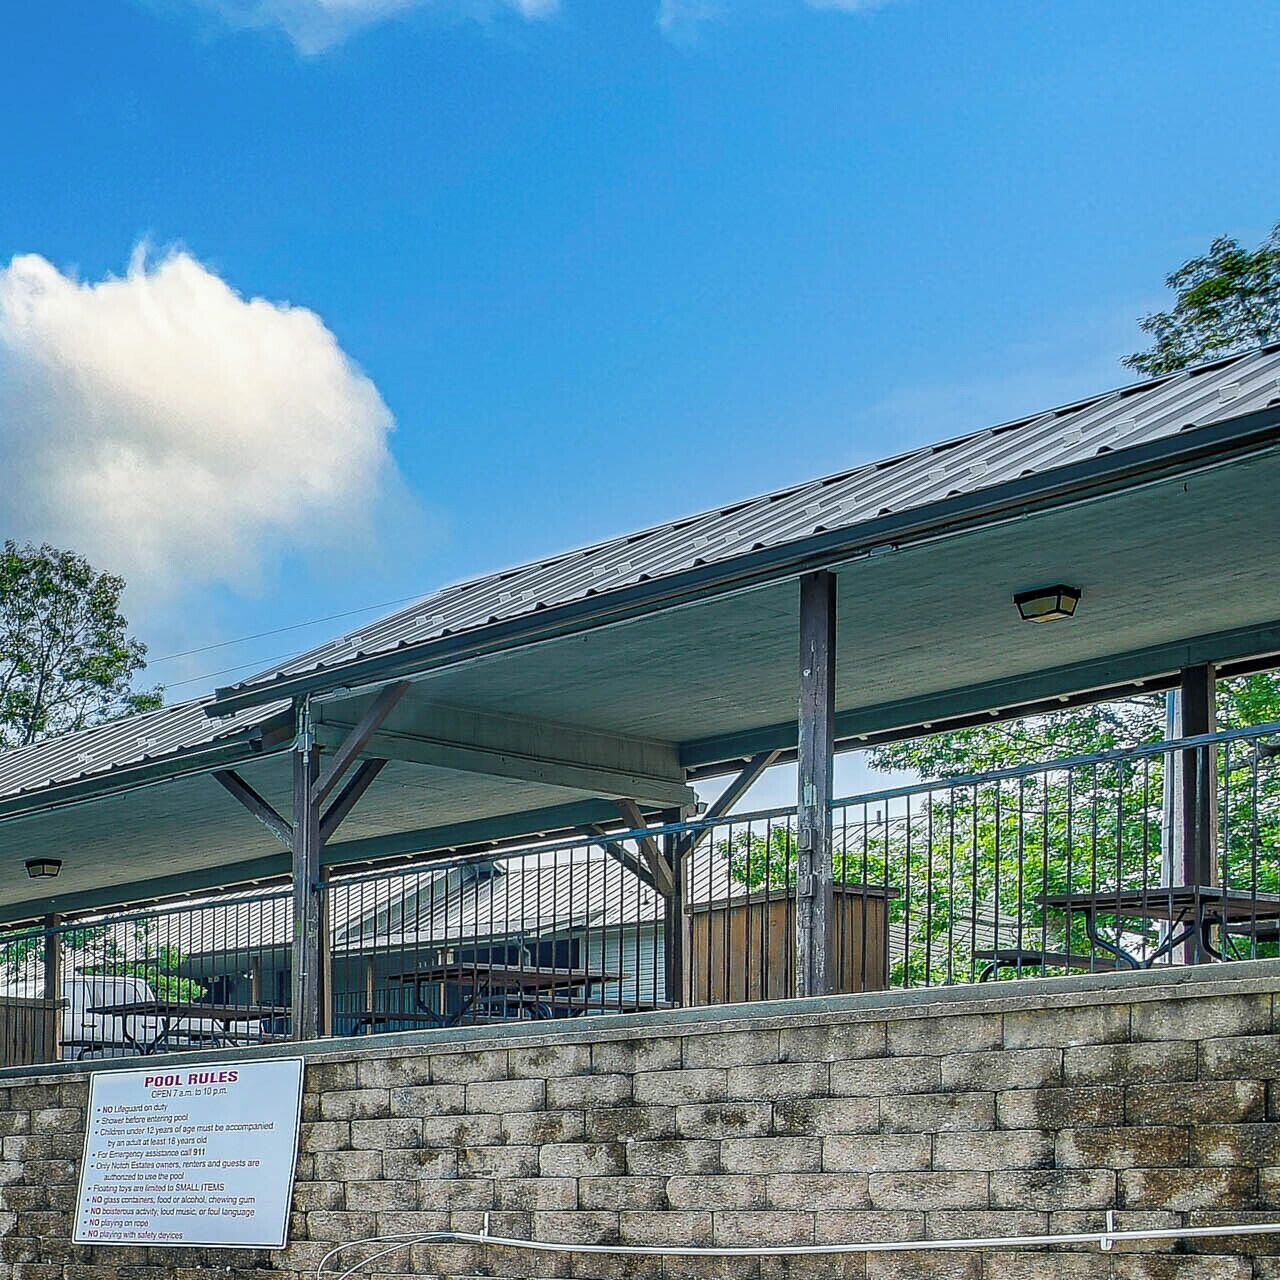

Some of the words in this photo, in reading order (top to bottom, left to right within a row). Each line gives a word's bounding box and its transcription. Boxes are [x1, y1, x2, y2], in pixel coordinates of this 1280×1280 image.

[145, 1075, 183, 1088] POOL
[188, 1071, 238, 1085] RULES
[150, 1090, 171, 1098] OPEN
[172, 1089, 177, 1097] 7
[202, 1087, 212, 1095] 10
[113, 1104, 143, 1114] Lifeguard
[153, 1103, 168, 1112] duty
[146, 1114, 172, 1124] entering
[173, 1113, 188, 1123] pool
[99, 1128, 125, 1136] Children
[126, 1127, 144, 1135] under
[196, 1124, 213, 1132] must
[214, 1123, 224, 1131] be
[224, 1121, 273, 1132] accompanied
[107, 1140, 116, 1148] by
[176, 1138, 195, 1146] years
[108, 1150, 143, 1159] Emergency
[144, 1149, 179, 1157] assistance
[180, 1148, 192, 1156] call
[95, 1163, 110, 1171] Only
[130, 1161, 154, 1169] Estates
[182, 1160, 206, 1168] renters
[221, 1159, 246, 1168] guests
[169, 1172, 184, 1181] pool
[92, 1185, 117, 1193] Floating
[118, 1185, 132, 1193] toys
[200, 1183, 225, 1191] ITEMS
[103, 1196, 120, 1205] glass
[207, 1196, 237, 1204] chewing
[221, 1208, 255, 1217] language
[100, 1219, 123, 1228] playing
[98, 1230, 122, 1239] playing
[137, 1231, 156, 1240] safety
